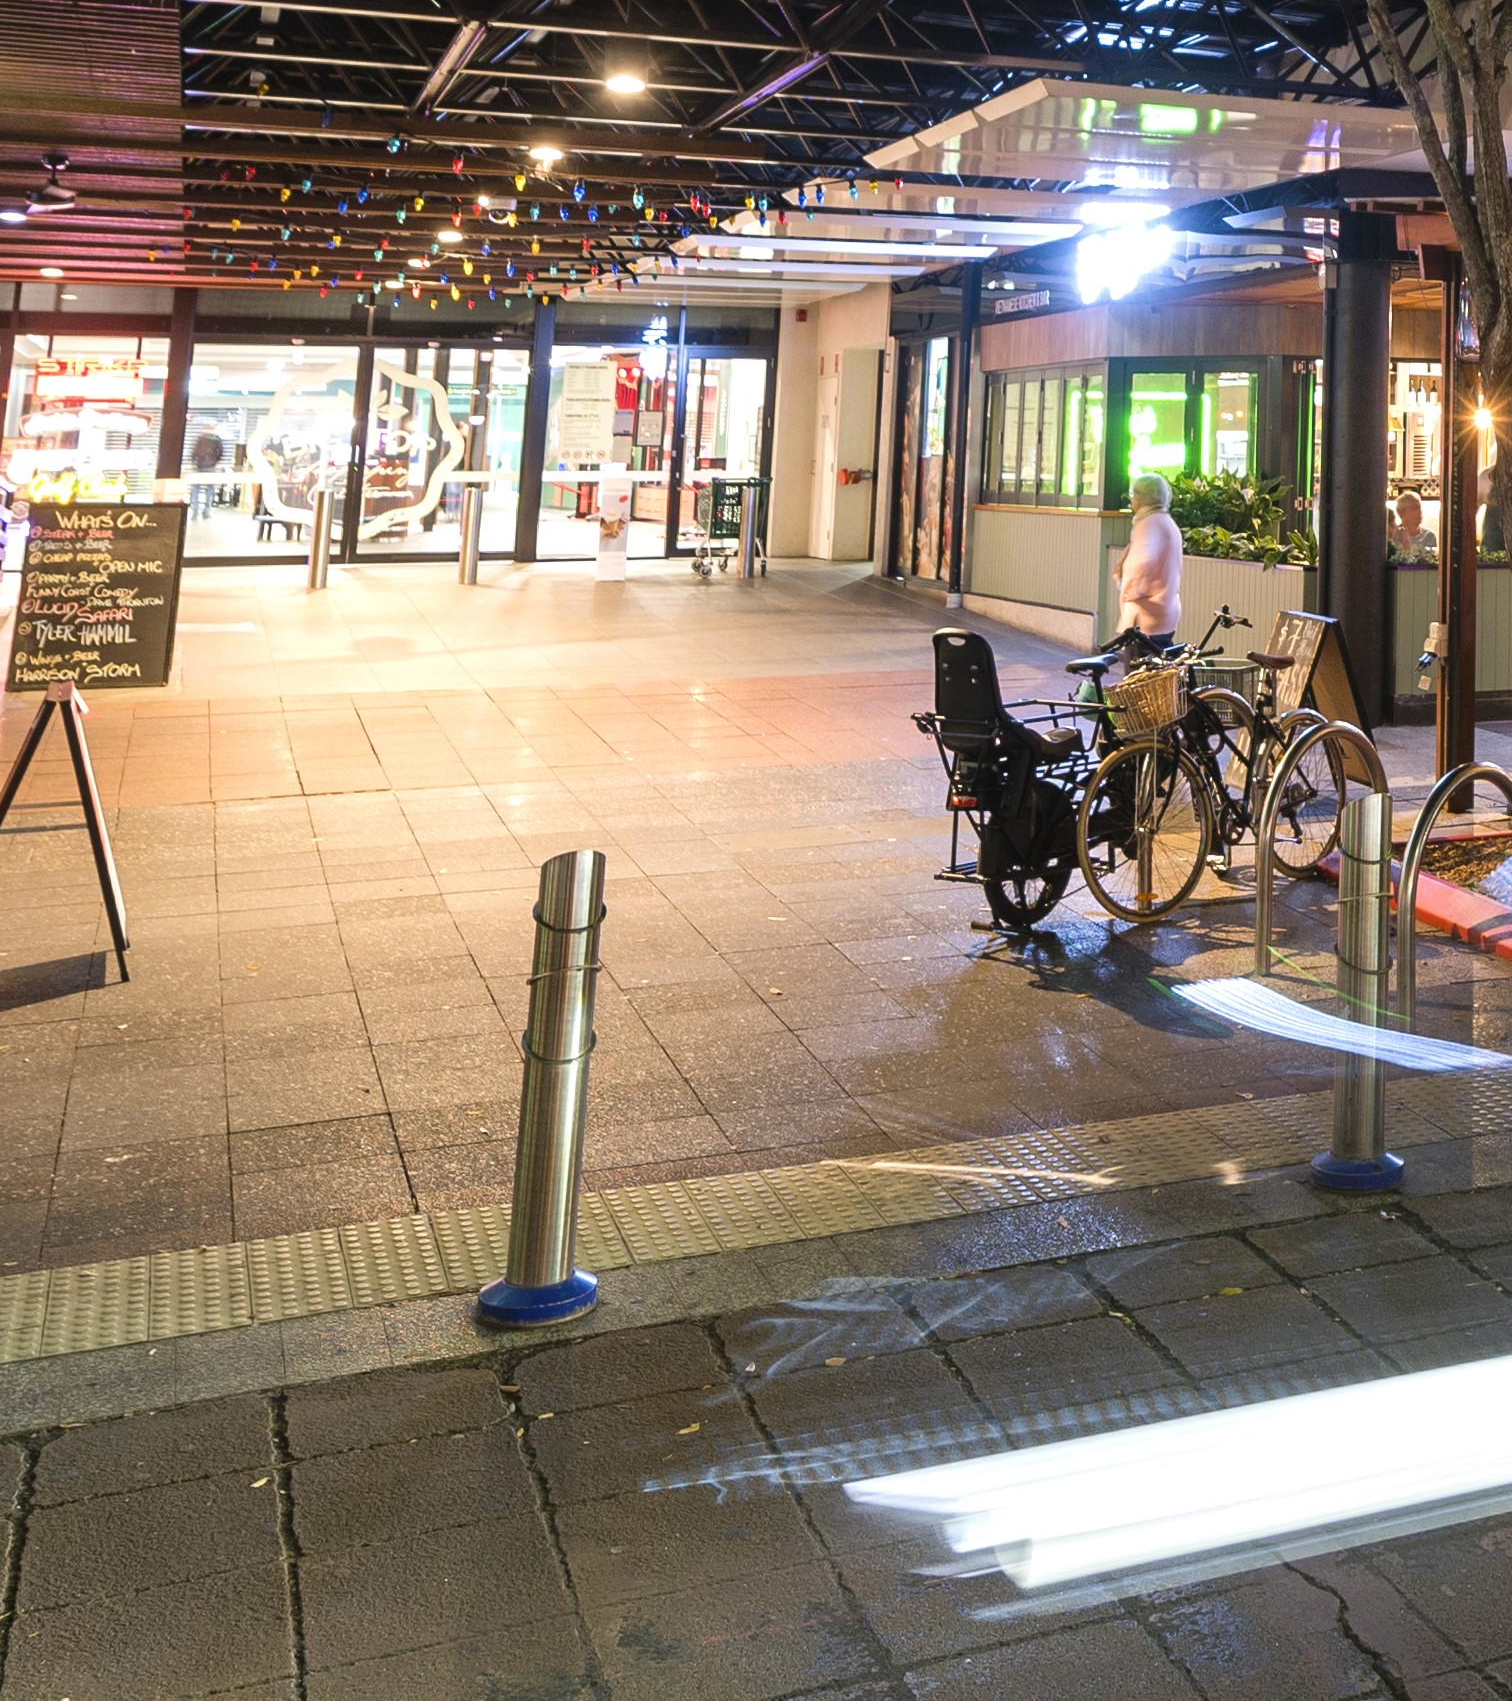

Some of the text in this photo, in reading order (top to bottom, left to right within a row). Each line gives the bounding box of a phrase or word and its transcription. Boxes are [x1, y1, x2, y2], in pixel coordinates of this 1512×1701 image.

[99, 561, 135, 574] OPEN
[138, 561, 163, 573] MIC
[26, 585, 61, 598] FUNNY
[74, 606, 135, 624] SAFARI
[32, 619, 77, 648] TYLER
[15, 662, 142, 684] HARRISON STORM
